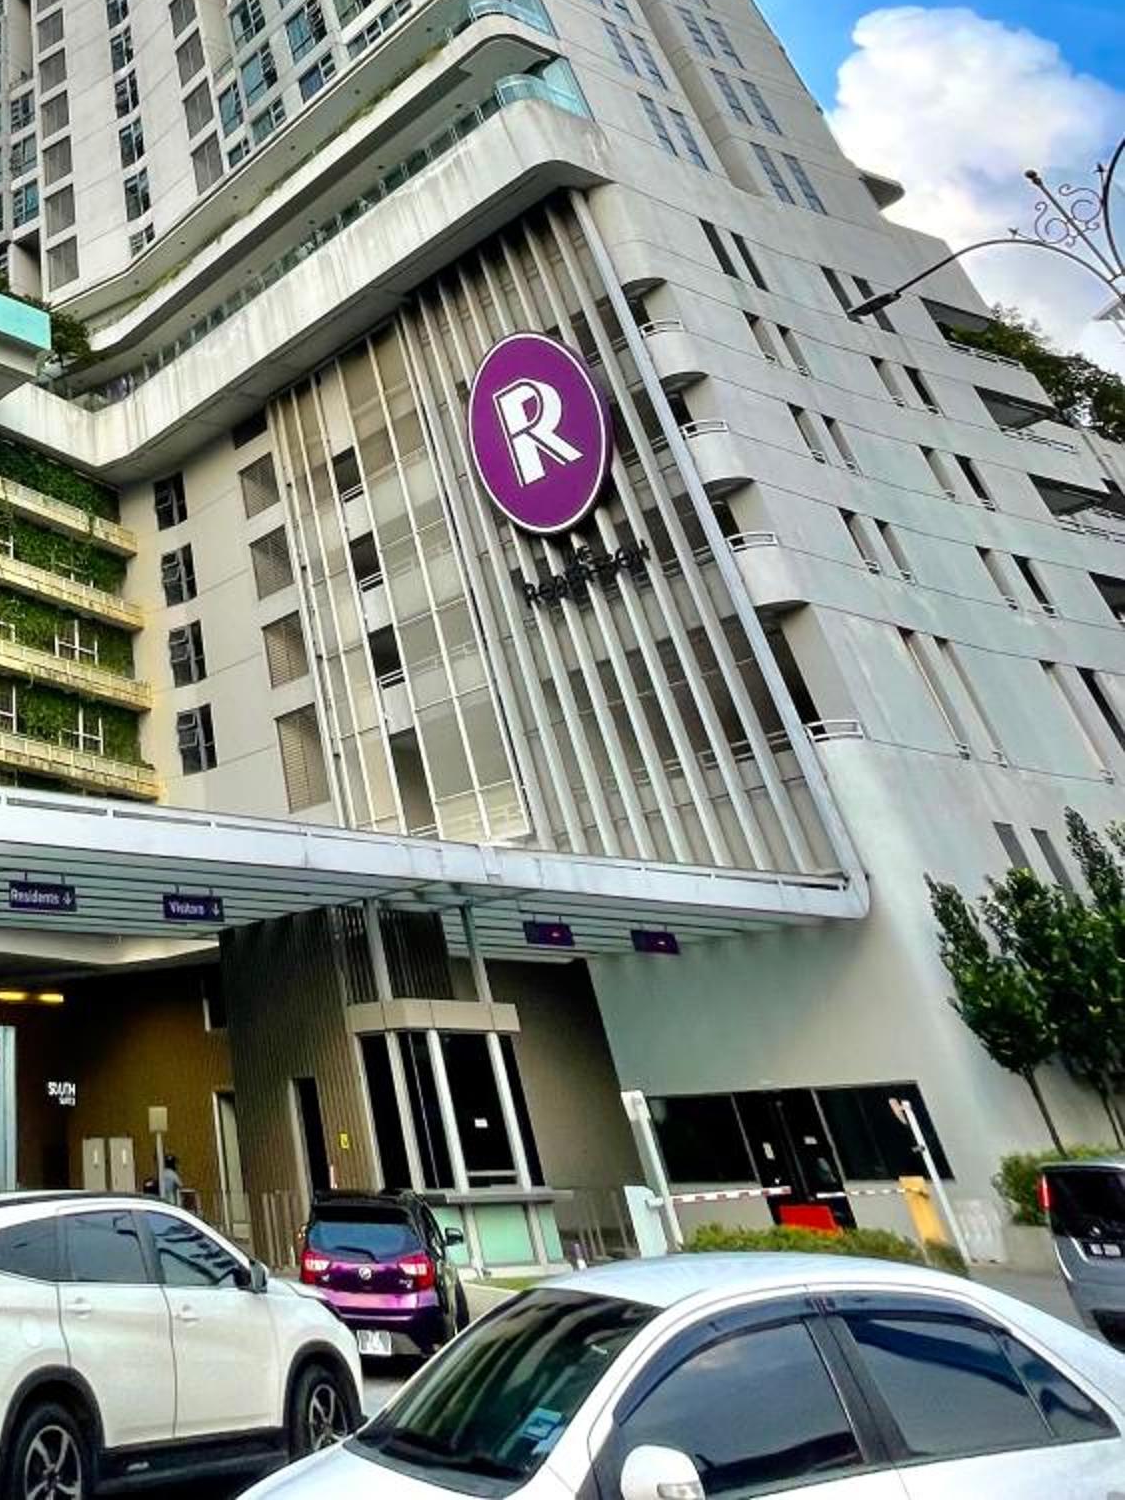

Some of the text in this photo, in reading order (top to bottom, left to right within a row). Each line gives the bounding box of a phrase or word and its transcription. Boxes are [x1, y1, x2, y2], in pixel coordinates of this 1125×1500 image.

[492, 377, 584, 489] R
[10, 888, 60, 905] Residents
[168, 900, 205, 916] Visitors
[48, 1081, 76, 1097] SOUTH
